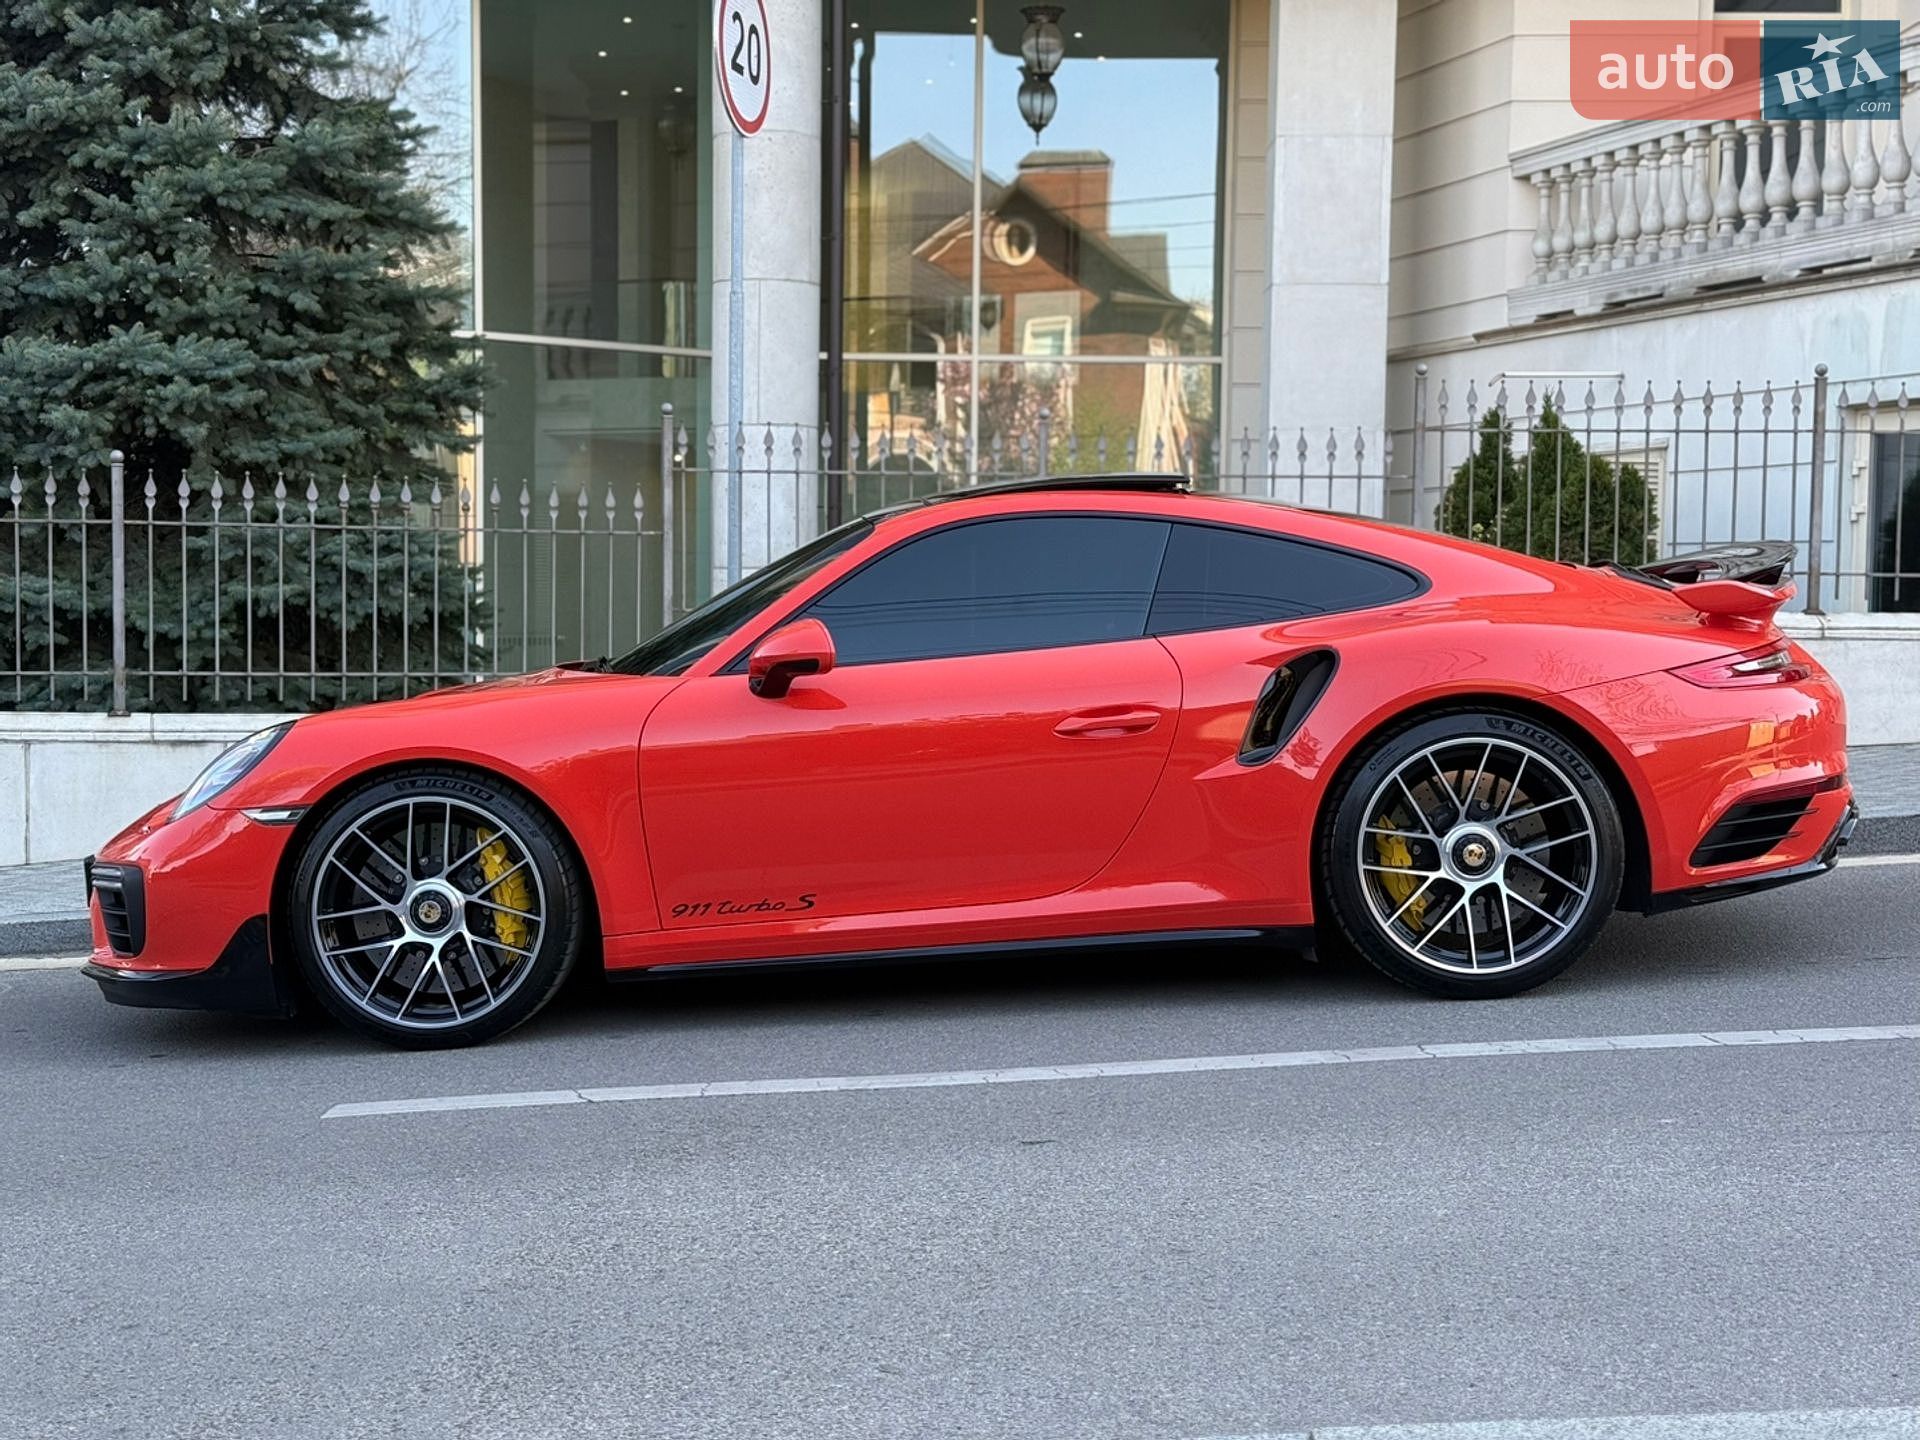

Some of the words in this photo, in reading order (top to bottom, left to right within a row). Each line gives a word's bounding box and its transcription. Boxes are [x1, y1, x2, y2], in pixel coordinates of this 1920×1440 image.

[731, 11, 761, 86] 20
[1510, 722, 1590, 780] MICHELIN
[415, 779, 491, 801] MICHELIN
[671, 902, 713, 919] 911
[785, 893, 817, 912] S
